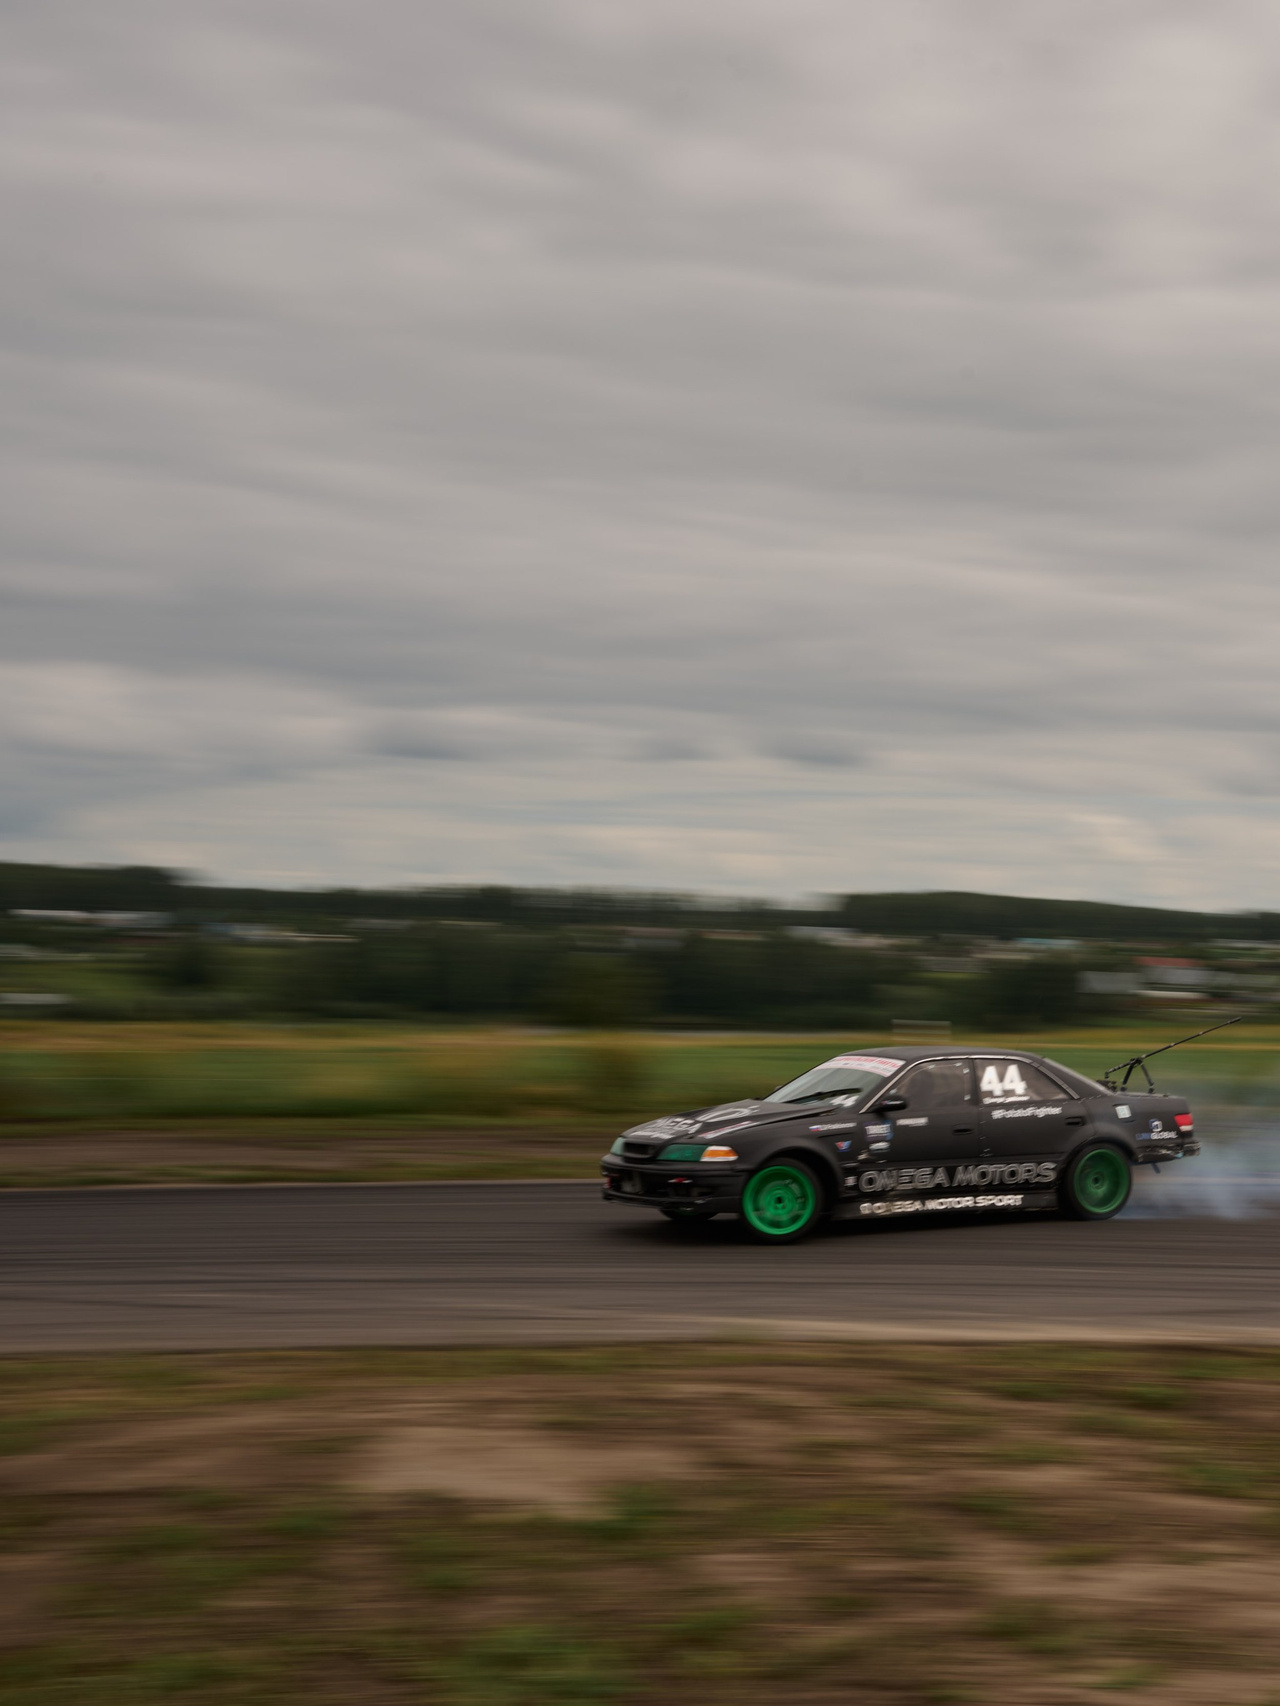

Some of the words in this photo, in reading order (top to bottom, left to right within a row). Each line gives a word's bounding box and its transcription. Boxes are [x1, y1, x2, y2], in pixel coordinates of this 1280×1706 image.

[980, 1064, 1027, 1096] 44
[858, 1167, 950, 1193] OMEGA
[952, 1161, 1059, 1187] MOTORS
